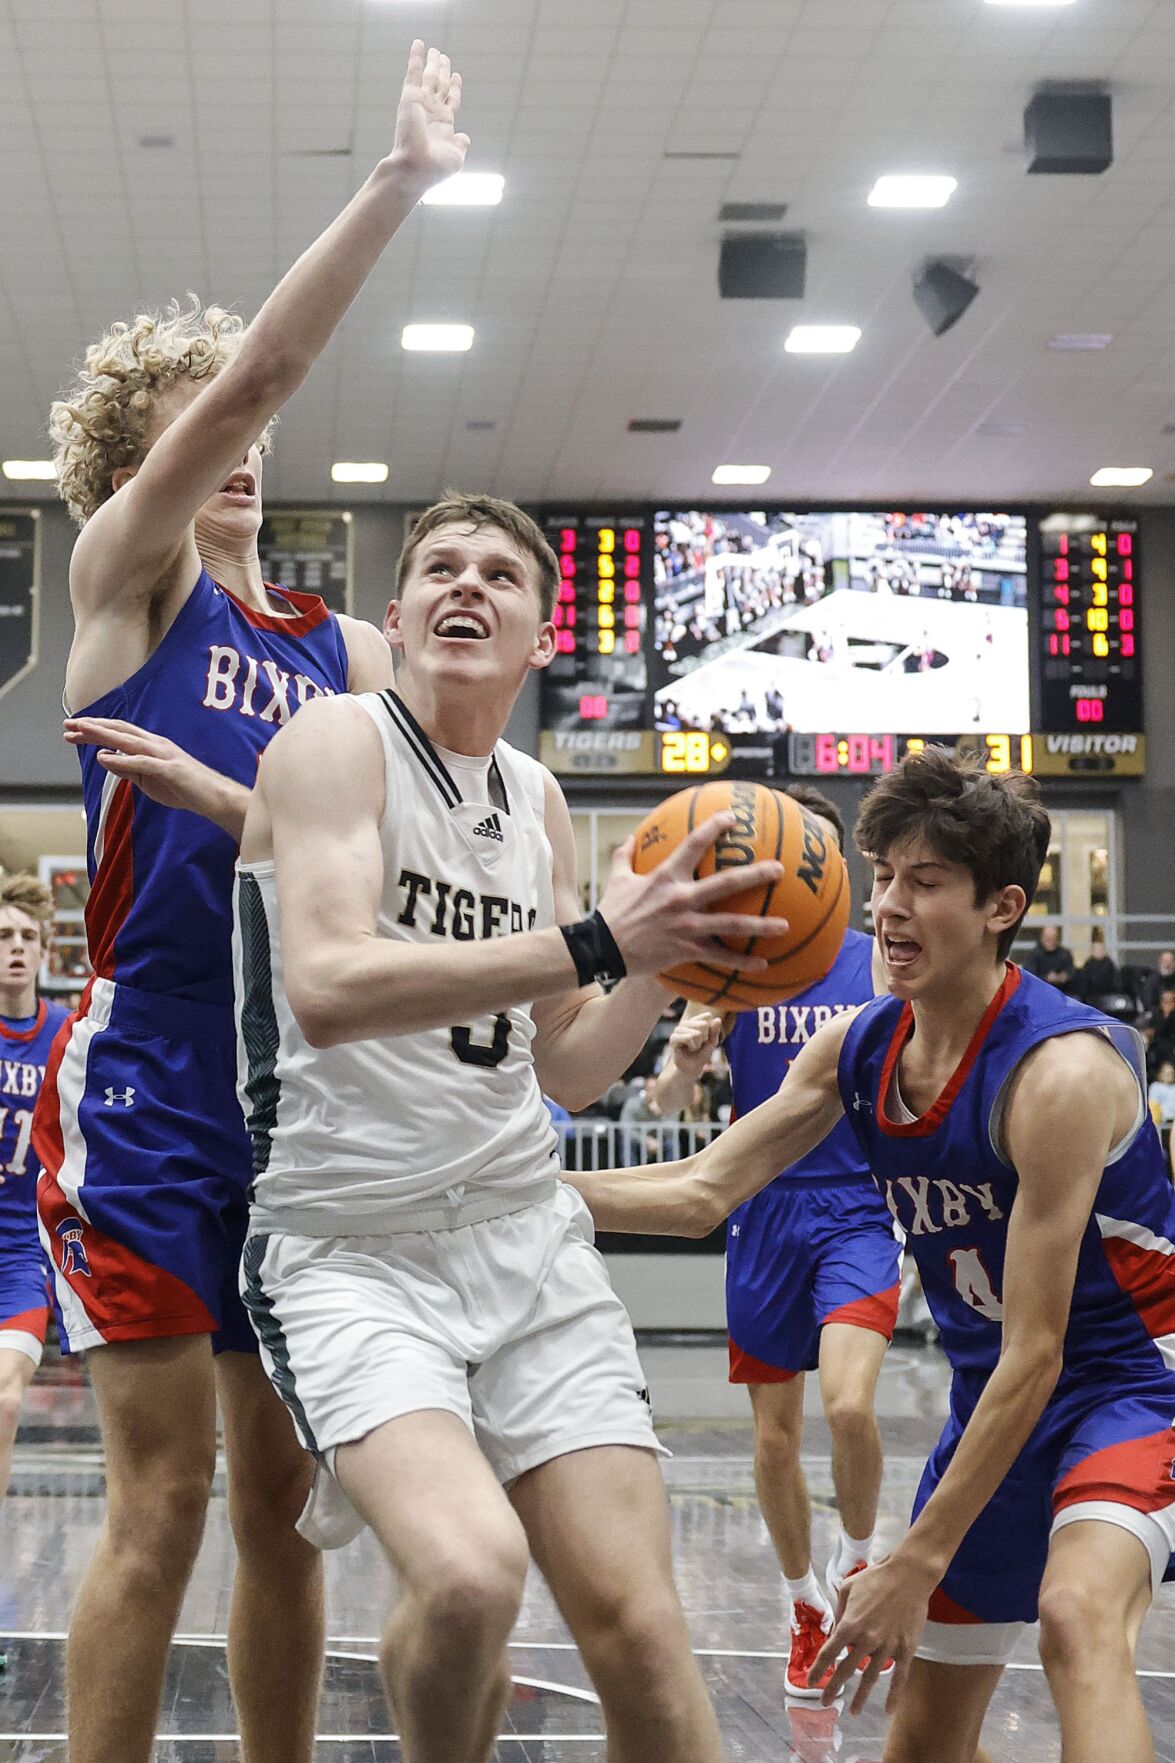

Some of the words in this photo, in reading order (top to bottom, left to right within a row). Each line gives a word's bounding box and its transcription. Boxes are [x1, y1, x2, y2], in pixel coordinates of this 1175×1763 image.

[1118, 532, 1132, 556] 0
[1118, 583, 1133, 606] 0
[1119, 607, 1133, 631] 0
[662, 732, 709, 773] 28
[816, 733, 893, 773] 6:04
[985, 734, 1032, 775] 31
[1047, 734, 1138, 753] VISITOR
[473, 827, 504, 842] adidas
